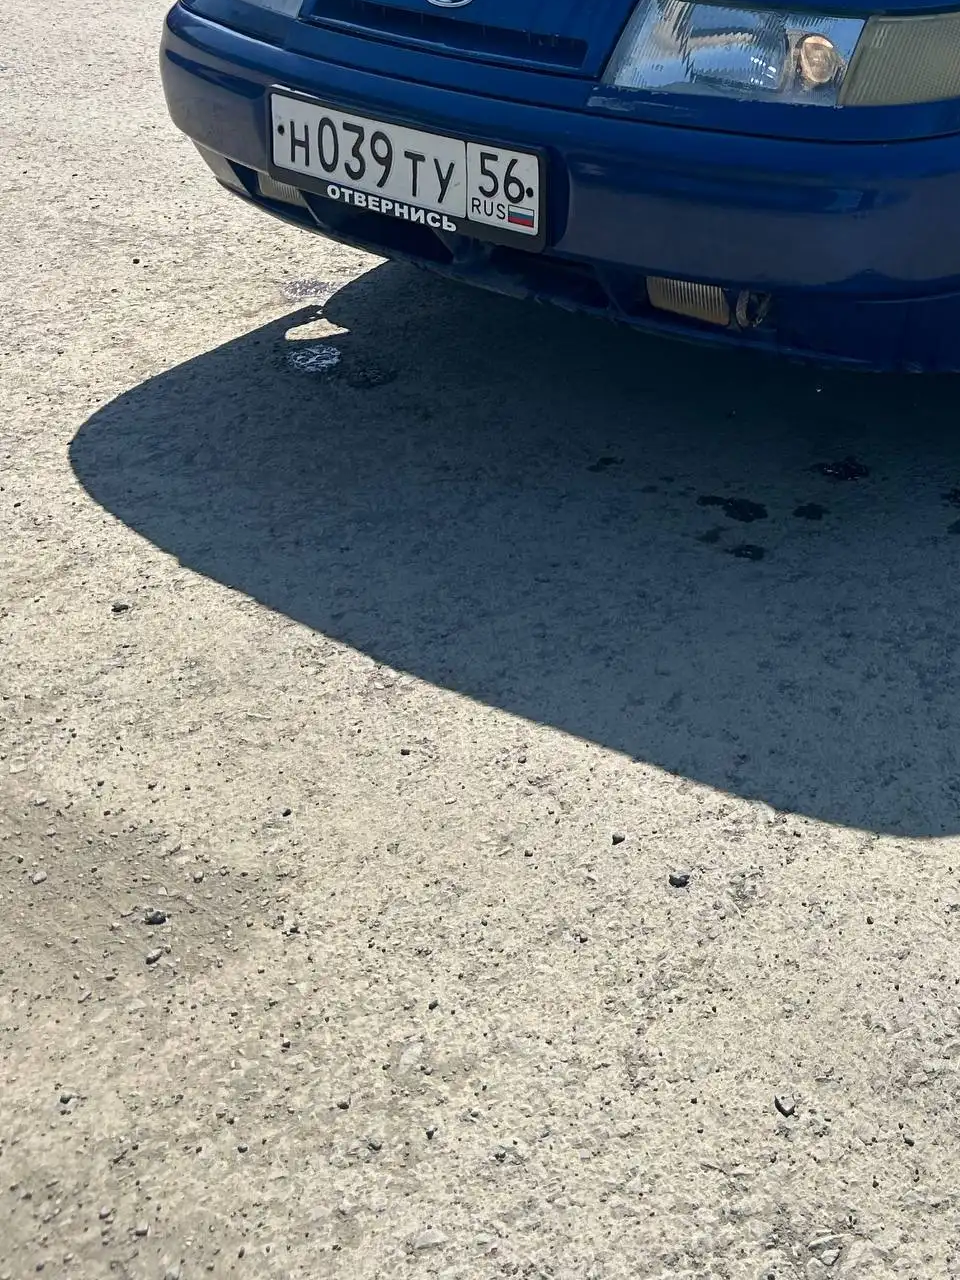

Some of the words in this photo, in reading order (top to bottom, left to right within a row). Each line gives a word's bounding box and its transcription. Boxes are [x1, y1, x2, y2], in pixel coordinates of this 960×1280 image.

[478, 151, 525, 204] 56
[326, 184, 457, 232] ОТВЕРНИСЬ
[471, 197, 506, 220] RUS
